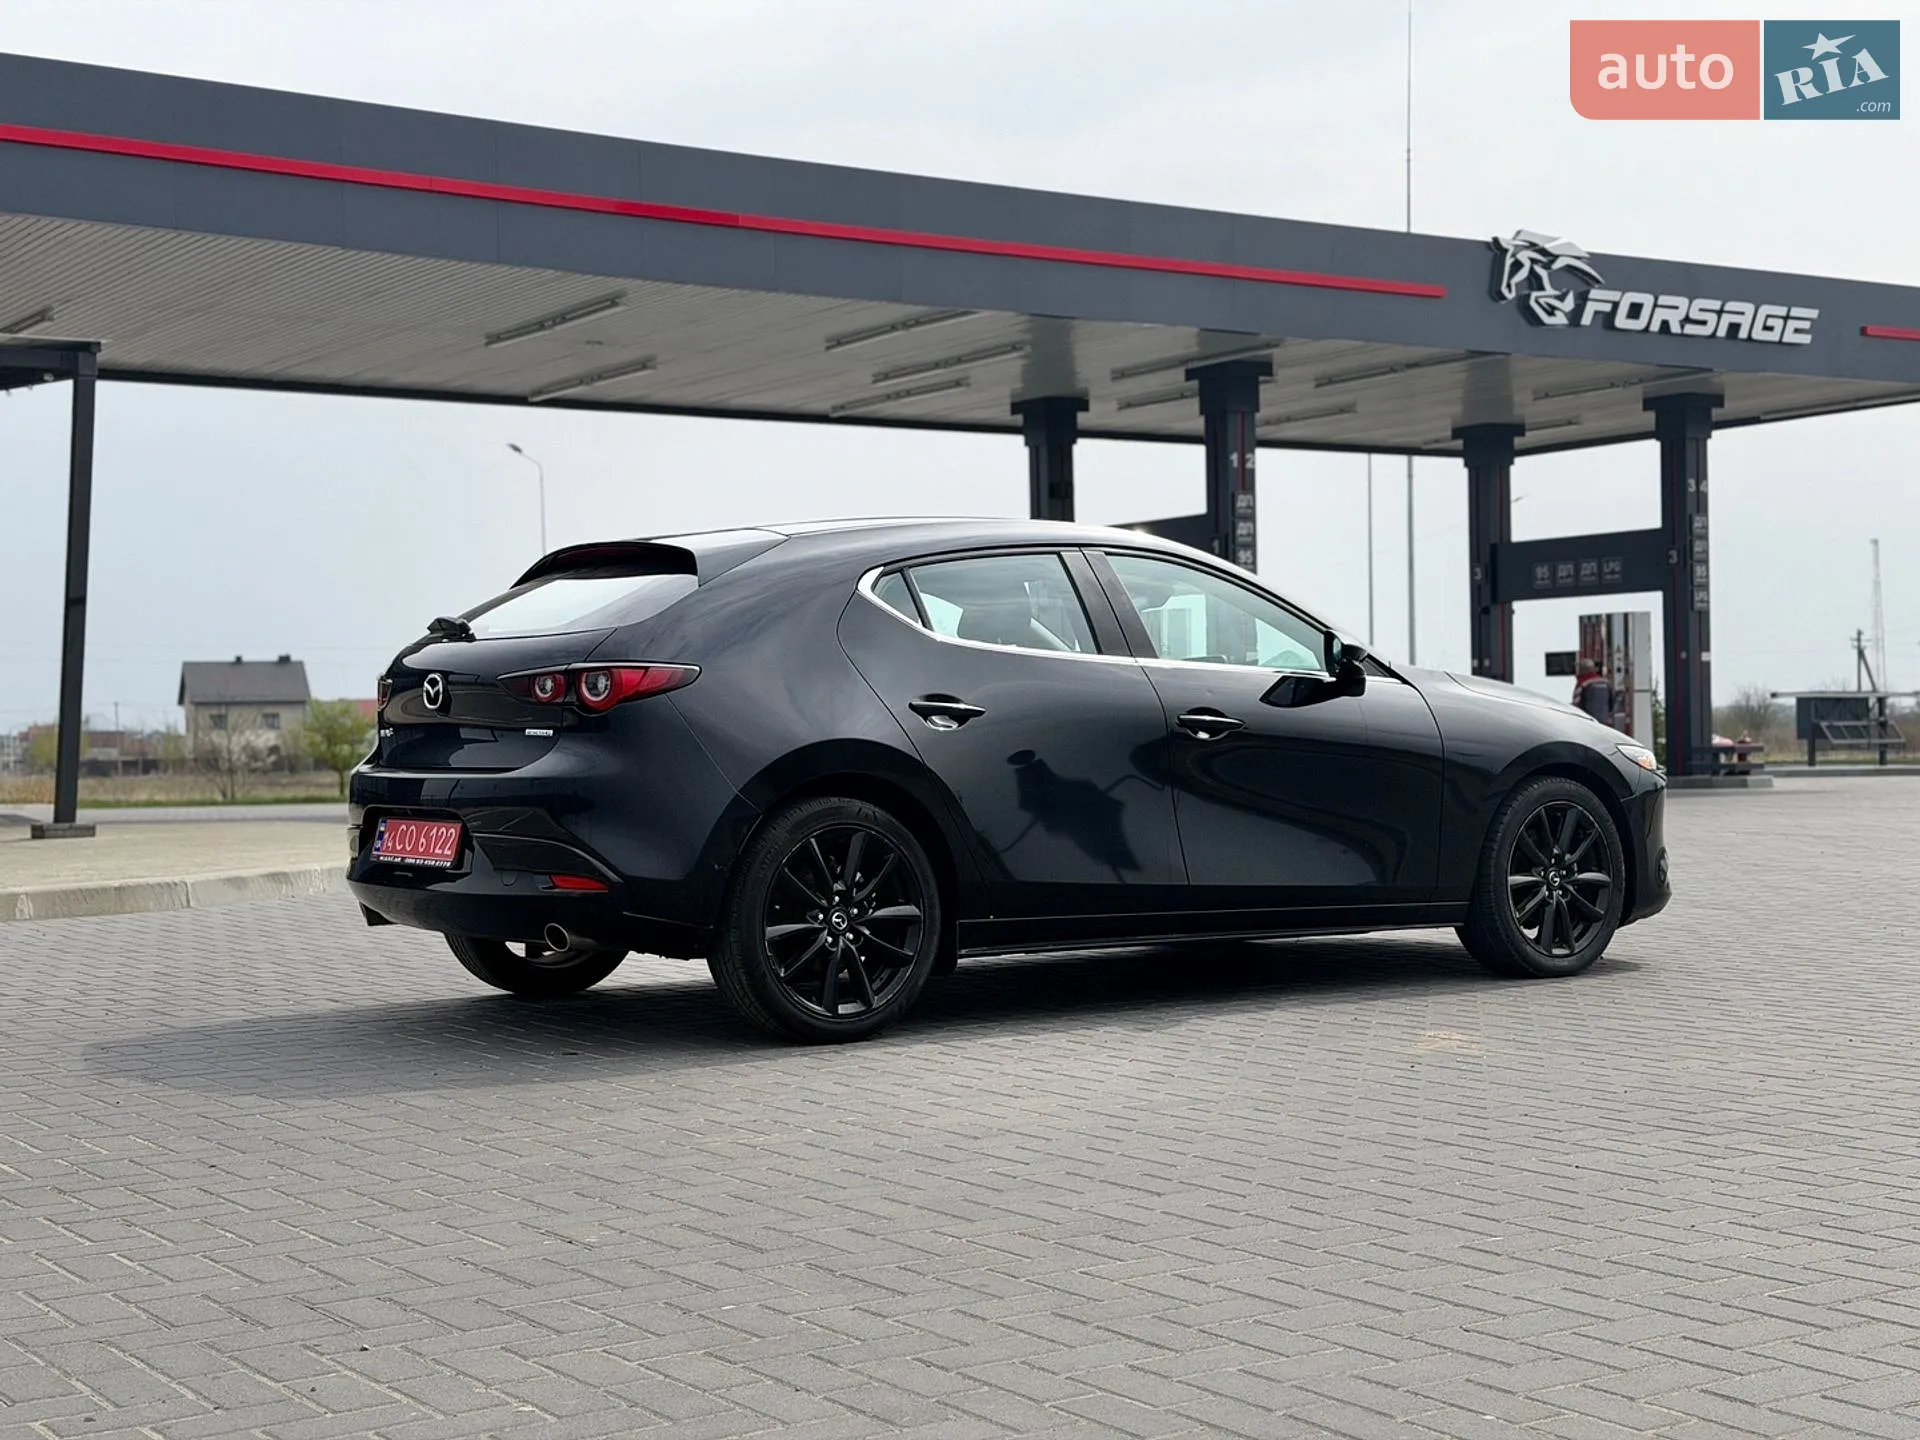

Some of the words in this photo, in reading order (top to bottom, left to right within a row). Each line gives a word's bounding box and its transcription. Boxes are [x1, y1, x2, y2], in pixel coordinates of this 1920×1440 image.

[1580, 289, 1819, 345] FORSAGE
[1230, 451, 1238, 468] 1
[1245, 453, 1255, 469] 2
[1687, 478, 1697, 493] 3
[1699, 479, 1708, 493] 4
[1668, 550, 1678, 564] 3
[396, 824, 416, 851] CO
[418, 825, 456, 855] 6122
